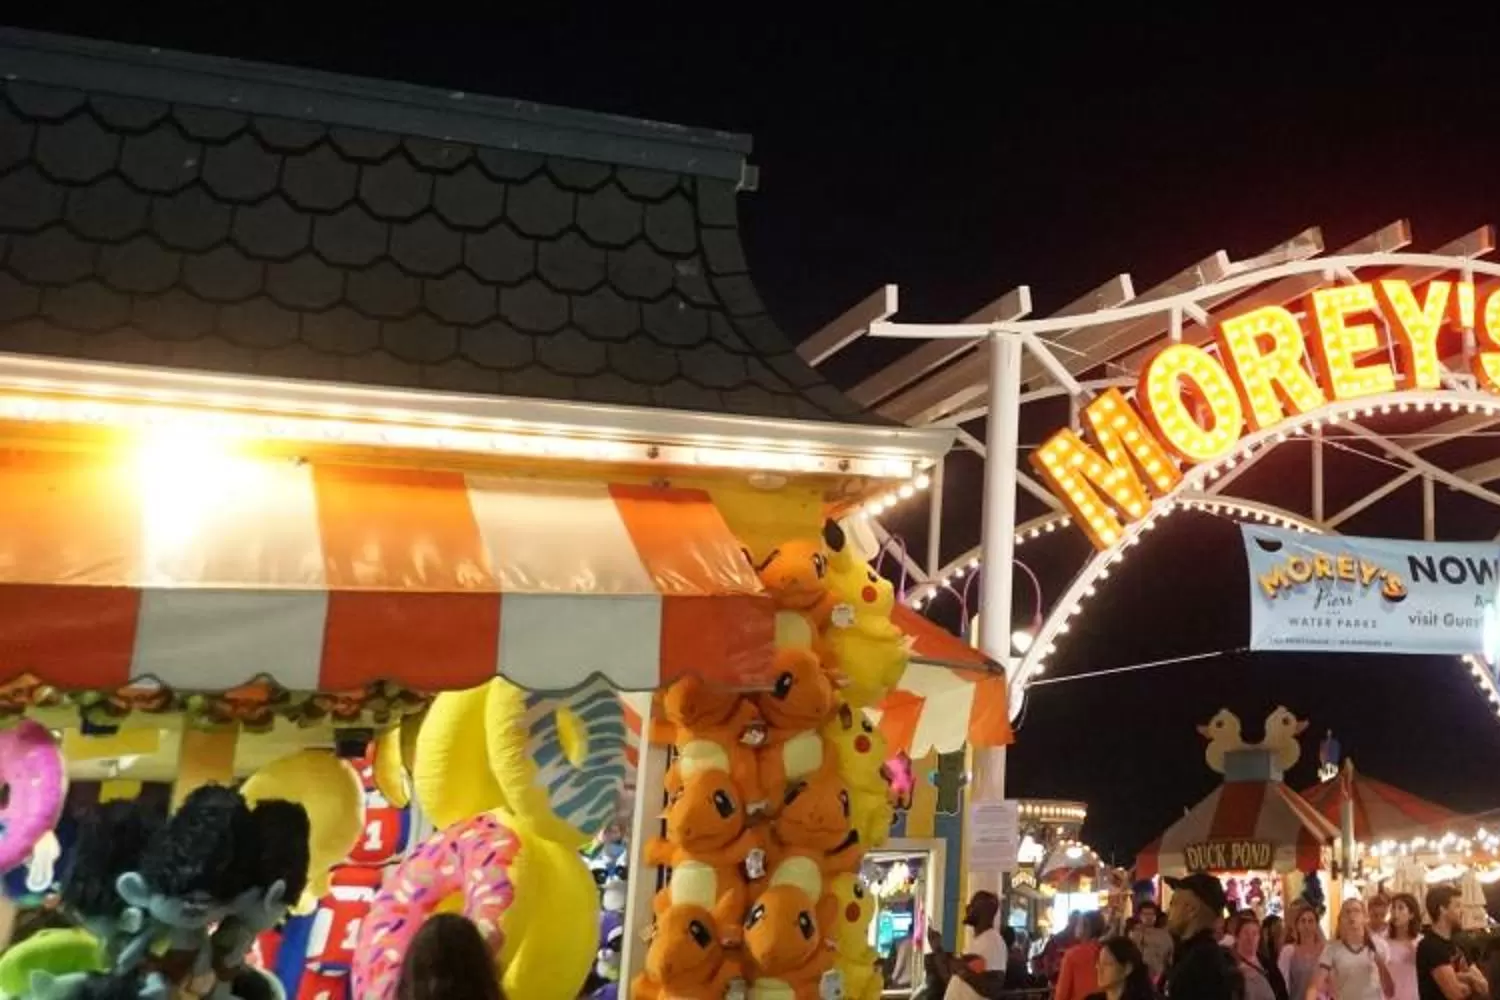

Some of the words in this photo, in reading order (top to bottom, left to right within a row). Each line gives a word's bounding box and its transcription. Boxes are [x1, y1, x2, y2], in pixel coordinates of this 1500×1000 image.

[1258, 552, 1408, 603] MOREY'S
[1406, 554, 1500, 586] NOW
[1288, 616, 1333, 629] WATER
[1337, 618, 1378, 630] PARKS
[1407, 609, 1439, 627] visit
[1187, 843, 1227, 871] DUCK
[1231, 841, 1270, 868] POND
